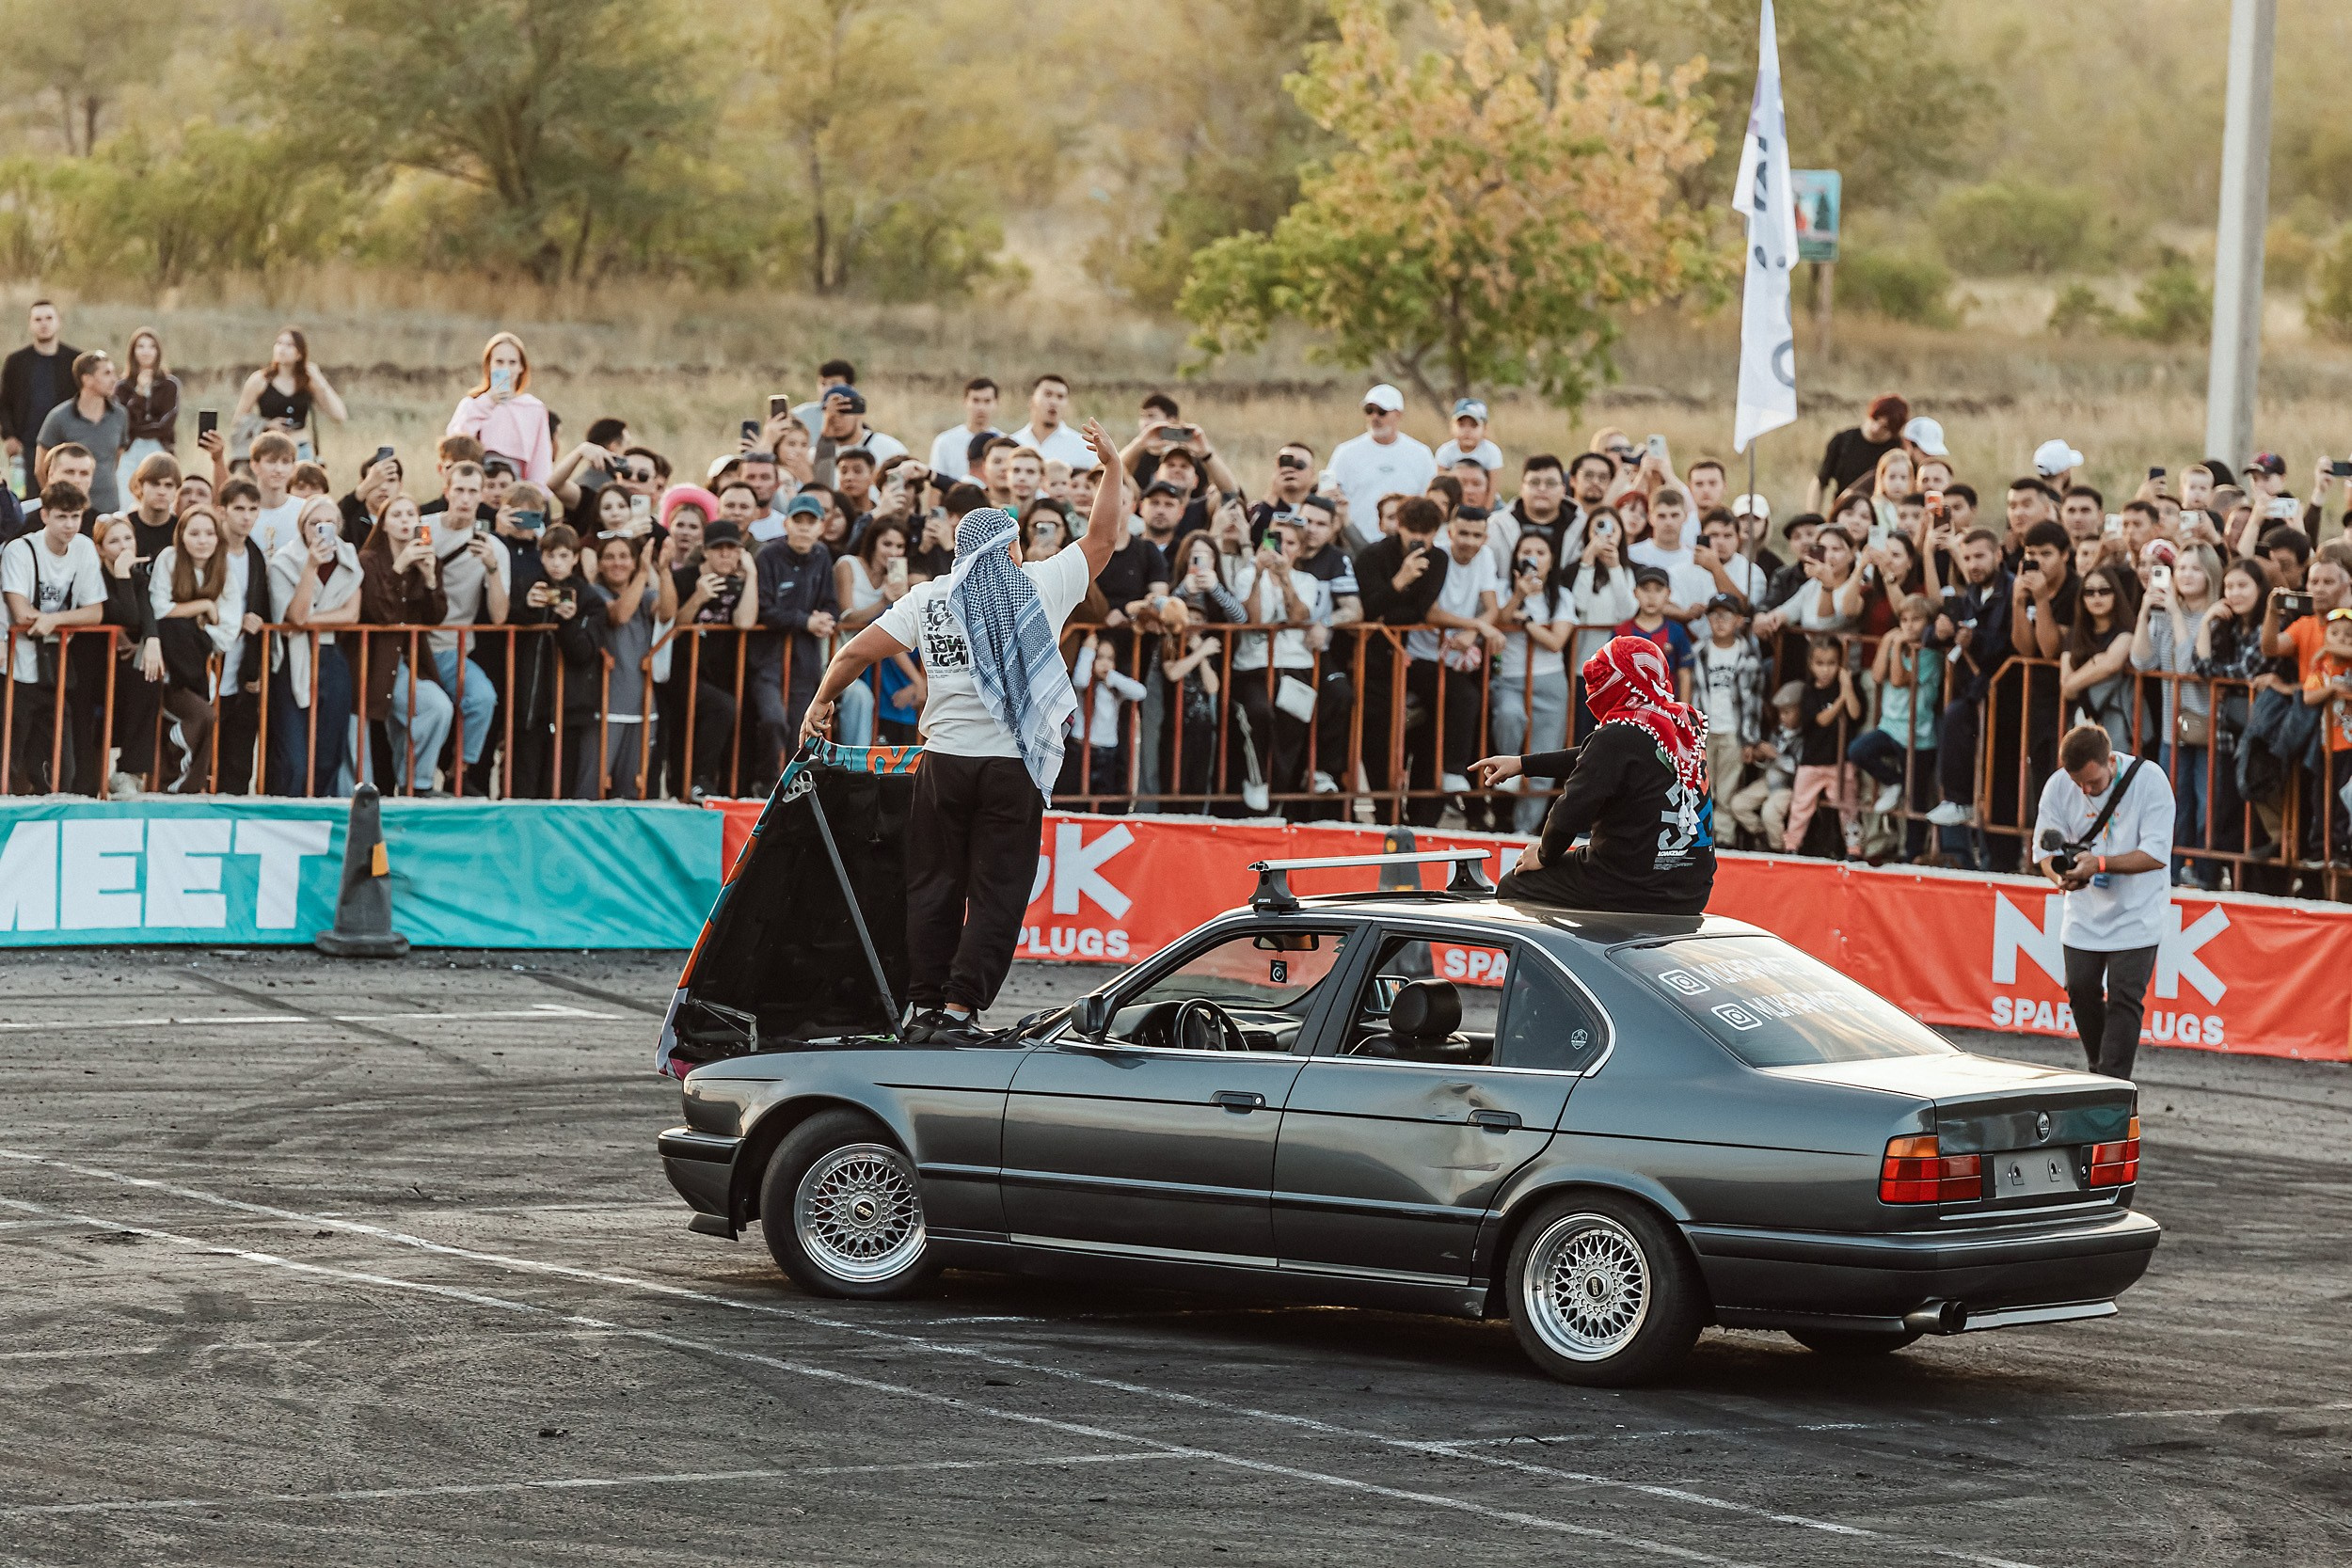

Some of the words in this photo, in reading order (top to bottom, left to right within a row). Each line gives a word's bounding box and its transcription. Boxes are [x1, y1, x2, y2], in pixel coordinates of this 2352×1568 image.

[1443, 948, 1509, 981] SPA
[1992, 889, 2232, 1006] NK
[1990, 995, 2078, 1032] SPAR
[2140, 1010, 2225, 1046] UGS
